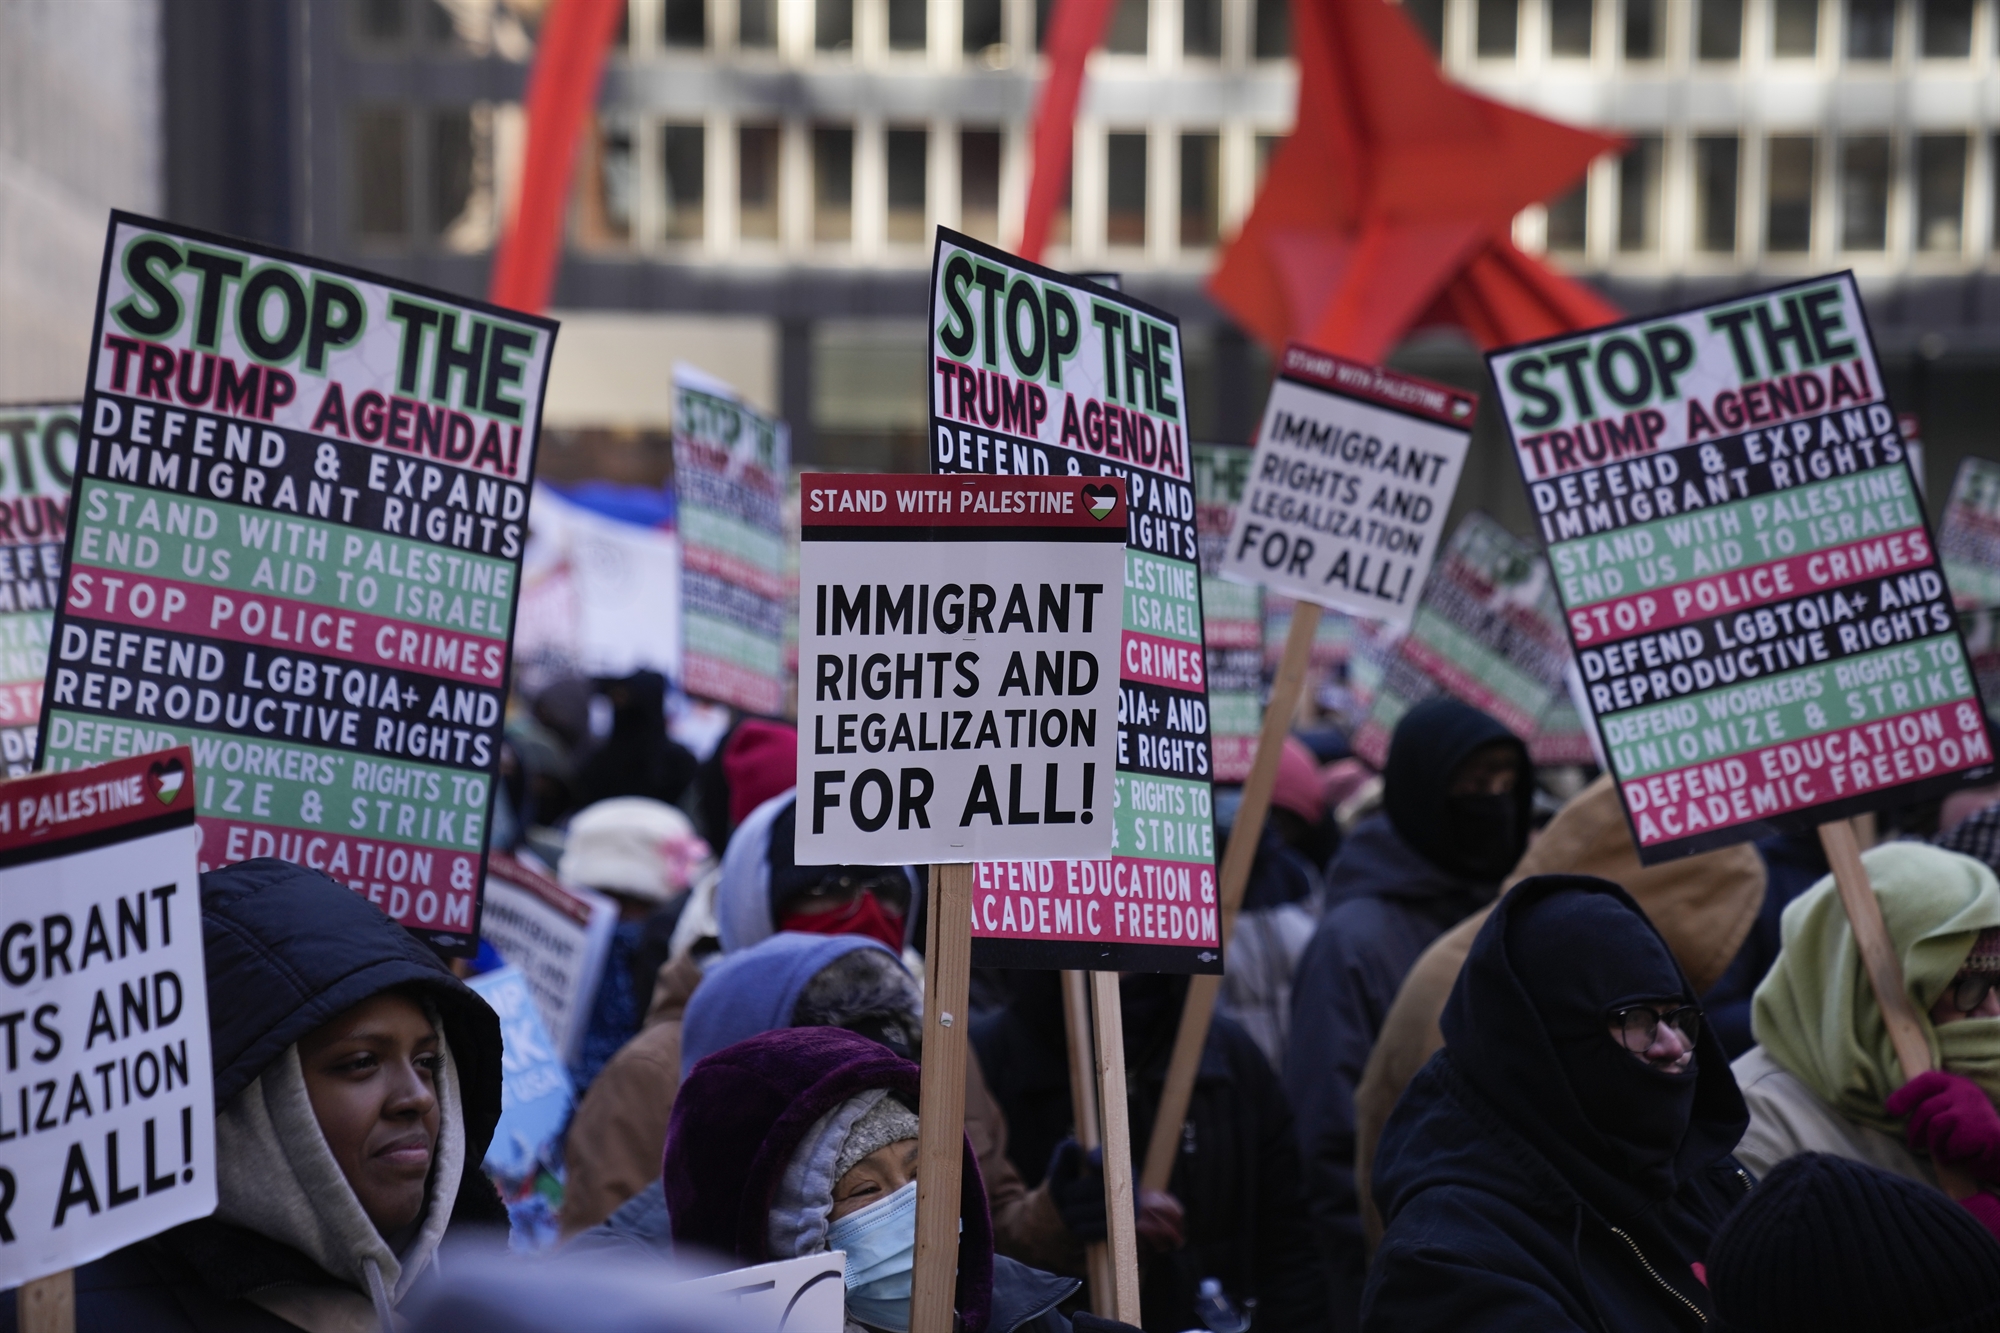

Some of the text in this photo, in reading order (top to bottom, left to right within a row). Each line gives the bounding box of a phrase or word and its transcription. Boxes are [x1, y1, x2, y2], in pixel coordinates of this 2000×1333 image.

[110, 235, 537, 424] STOP THE
[937, 250, 1180, 423] STOP THE
[1506, 284, 1861, 430] STOP THE
[105, 333, 522, 480] TRUMP AGENDA!
[936, 356, 1184, 478] TRUMP AGENDA!
[1286, 349, 1448, 412] STAND WITH PALESTINE
[1522, 360, 1873, 477] TRUMP AGENDA!
[87, 438, 520, 559] IMMIGRANT RIGHTS
[93, 398, 526, 520] DEFEND & EXPAND
[937, 425, 1049, 475] DEFEND
[1260, 452, 1432, 524] RIGHTS AND
[1270, 410, 1447, 488] IMMIGRANT
[1533, 404, 1894, 514] DEFEND & EXPAND
[1541, 435, 1903, 543] IMMIGRANT RIGHTS
[86, 488, 509, 599] STAND WITH PALESTINE
[810, 489, 1074, 514] STAND WITH PALESTINE
[1130, 512, 1197, 559] IGHTS
[1250, 489, 1424, 558] LEGALIZATION
[1556, 529, 1655, 575] STAND
[1665, 509, 1741, 548] WITH
[1751, 471, 1908, 528] PALESTINE
[80, 528, 503, 634] END US AID TO ISRAEL
[1236, 522, 1315, 579] FOR
[1324, 550, 1413, 604] ALL!
[1563, 501, 1918, 605] END US AID TO ISRAEL
[1571, 533, 1930, 641] STOP POLICE CRIMES
[69, 573, 186, 623] STOP
[210, 596, 357, 653] POLICE
[375, 625, 501, 679] CRIMES
[815, 583, 1104, 636] IMMIGRANT
[1132, 594, 1198, 638] ISRAEL
[1580, 570, 1943, 683] DEFEND LGBTQIA+ AND
[1591, 633, 1831, 714] REPRODUCTIVE
[1839, 603, 1953, 653] RIGHTS
[60, 624, 225, 682] DEFEND
[244, 652, 419, 710] LGBTQIA+
[427, 686, 498, 728] AND
[816, 651, 980, 701] RIGHTS
[998, 650, 1099, 697] AND
[1126, 639, 1202, 685] CRIMES
[1607, 639, 1960, 747] DEFEND WORKERS' RIGHTS TO
[53, 667, 359, 745] REPRODUCTIVE
[375, 718, 492, 768] RIGHTS
[814, 708, 1097, 754] LEGALIZATION
[1138, 734, 1208, 775] RIGHTS
[1167, 696, 1207, 734] AND
[1613, 666, 1971, 777] UNIONIZE & STRIKE
[1625, 703, 1981, 813] DEFEND EDUCATION &
[18, 775, 144, 830] PALESTINE
[300, 790, 323, 824] &
[348, 798, 482, 847] STRIKE
[352, 761, 440, 801] RIGHTS
[452, 775, 485, 809] TO
[812, 767, 934, 835] FOR
[959, 762, 1096, 828] ALL!
[1131, 780, 1185, 815] RIGHTS
[1189, 788, 1210, 818] TO
[1638, 731, 1990, 844] ACADEMIC FREEDOM
[226, 826, 433, 885] EDUCATION
[450, 857, 472, 890] &
[973, 861, 1214, 904] EFEND EDUCATION &
[1135, 817, 1213, 857] STRIKE
[1, 884, 179, 986] GRANT
[348, 880, 471, 927] EDOM
[1115, 902, 1216, 942] FREEDOM
[84, 970, 183, 1050] AND
[0, 1038, 189, 1142] LIZATION
[53, 1105, 195, 1229] ALL!
